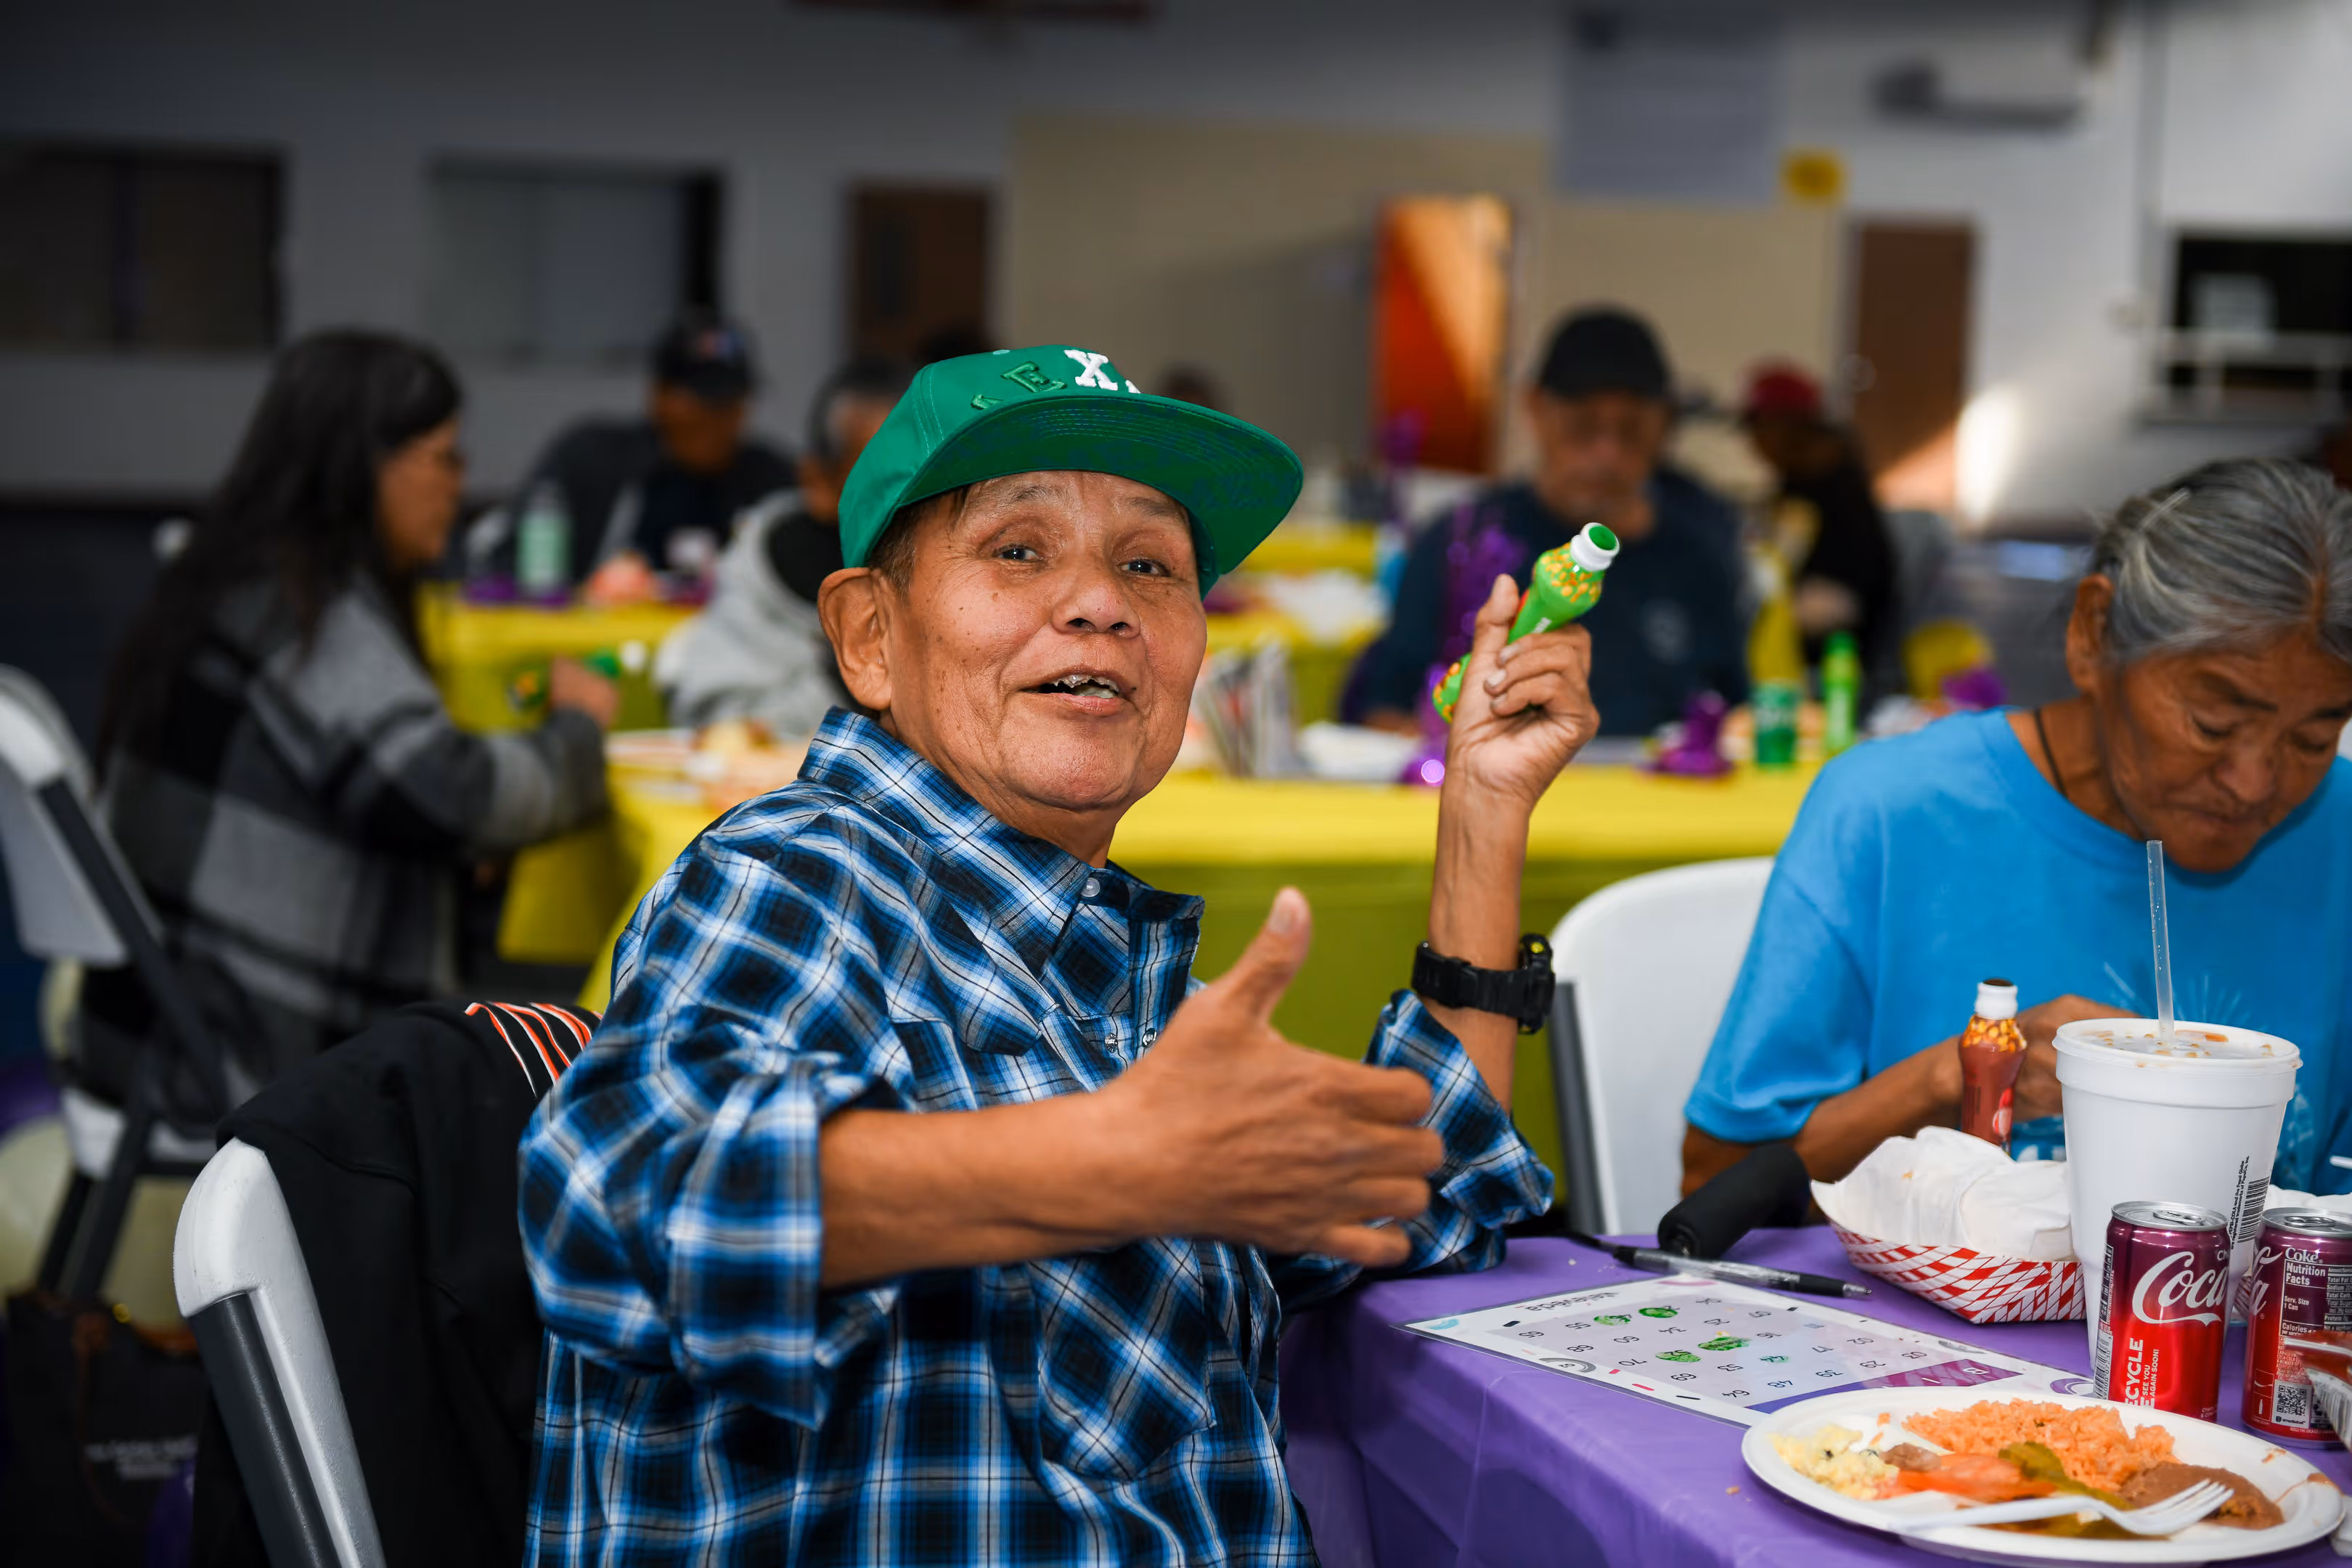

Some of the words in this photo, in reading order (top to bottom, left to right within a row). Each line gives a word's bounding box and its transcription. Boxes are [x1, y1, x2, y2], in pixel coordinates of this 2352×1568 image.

[2285, 1247, 2319, 1263] Coke
[2286, 1262, 2326, 1277] Nutrition
[2285, 1273, 2310, 1285] Facts
[2282, 1323, 2307, 1333] Calories
[1901, 1351, 1927, 1360] 03
[1962, 1366, 1989, 1375] B
[2124, 1337, 2143, 1406] ECYCLE
[1670, 1373, 1697, 1381] 69
[1722, 1389, 1750, 1398] 64
